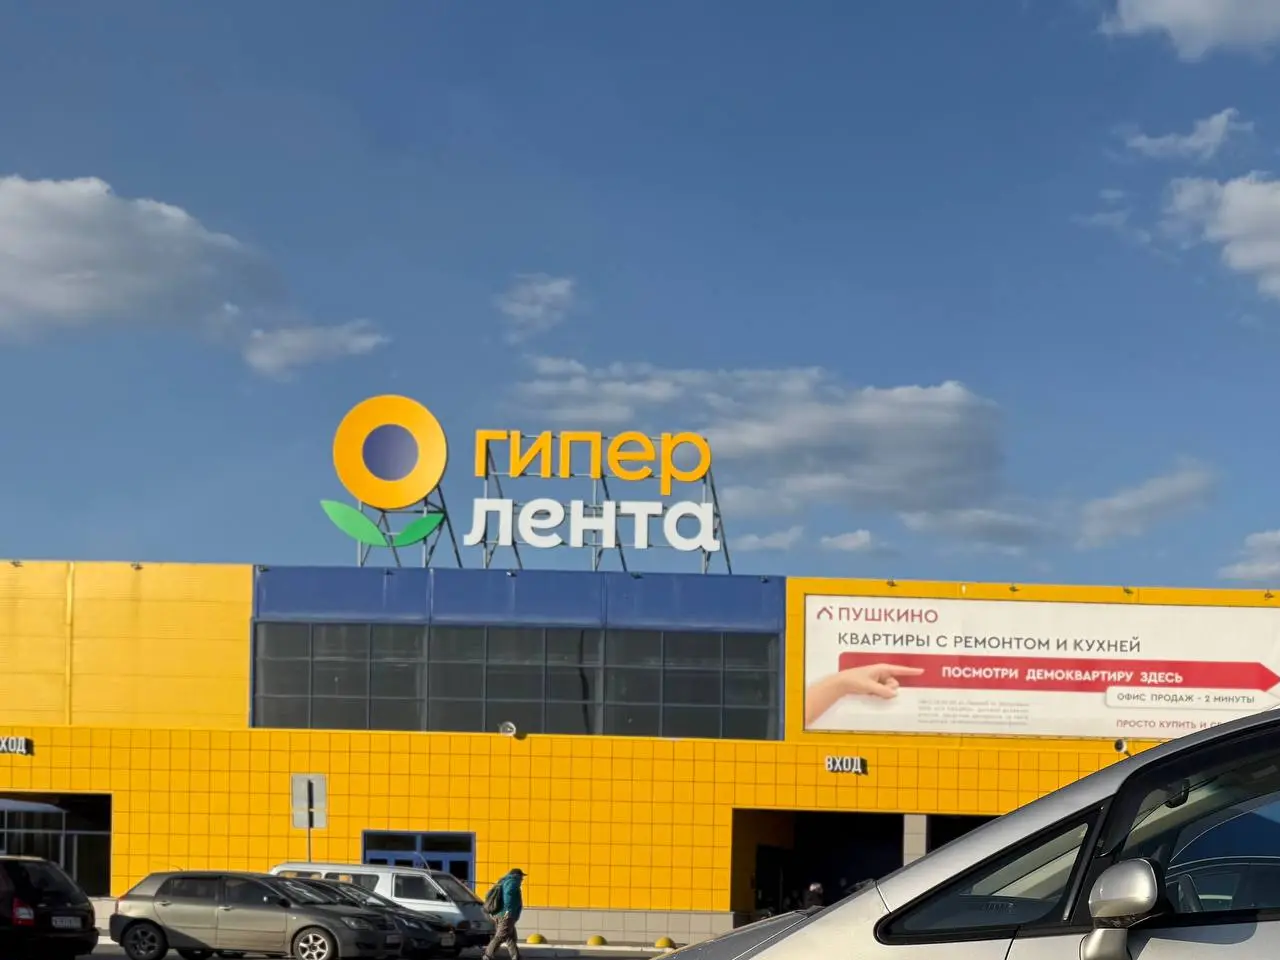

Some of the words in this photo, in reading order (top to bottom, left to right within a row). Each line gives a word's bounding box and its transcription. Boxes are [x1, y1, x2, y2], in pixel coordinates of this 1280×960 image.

[475, 429, 712, 496] гипер
[463, 498, 721, 552] лента
[838, 606, 939, 624] ПУШКИНО
[838, 632, 931, 648] КВАРТИРЫ
[936, 635, 948, 648] С
[953, 635, 1051, 651] РЕМОНТОМ
[1056, 638, 1068, 652] И
[1074, 636, 1141, 653] КУХНЕЙ
[942, 665, 1019, 680] ПОСМОТРИ
[1025, 667, 1134, 683] ДЕМОКВАРТИРУ
[1140, 671, 1184, 684] ЗДЕСЬ
[1117, 692, 1147, 702] ОФИС
[1150, 693, 1195, 704] ПРОДАЖ
[1204, 694, 1211, 703] 2
[1213, 695, 1256, 704] МИНУТЫ
[1116, 718, 1156, 729] ПРОСТО
[1158, 720, 1197, 730] КУПИТЬ
[825, 755, 862, 773] ВХОД
